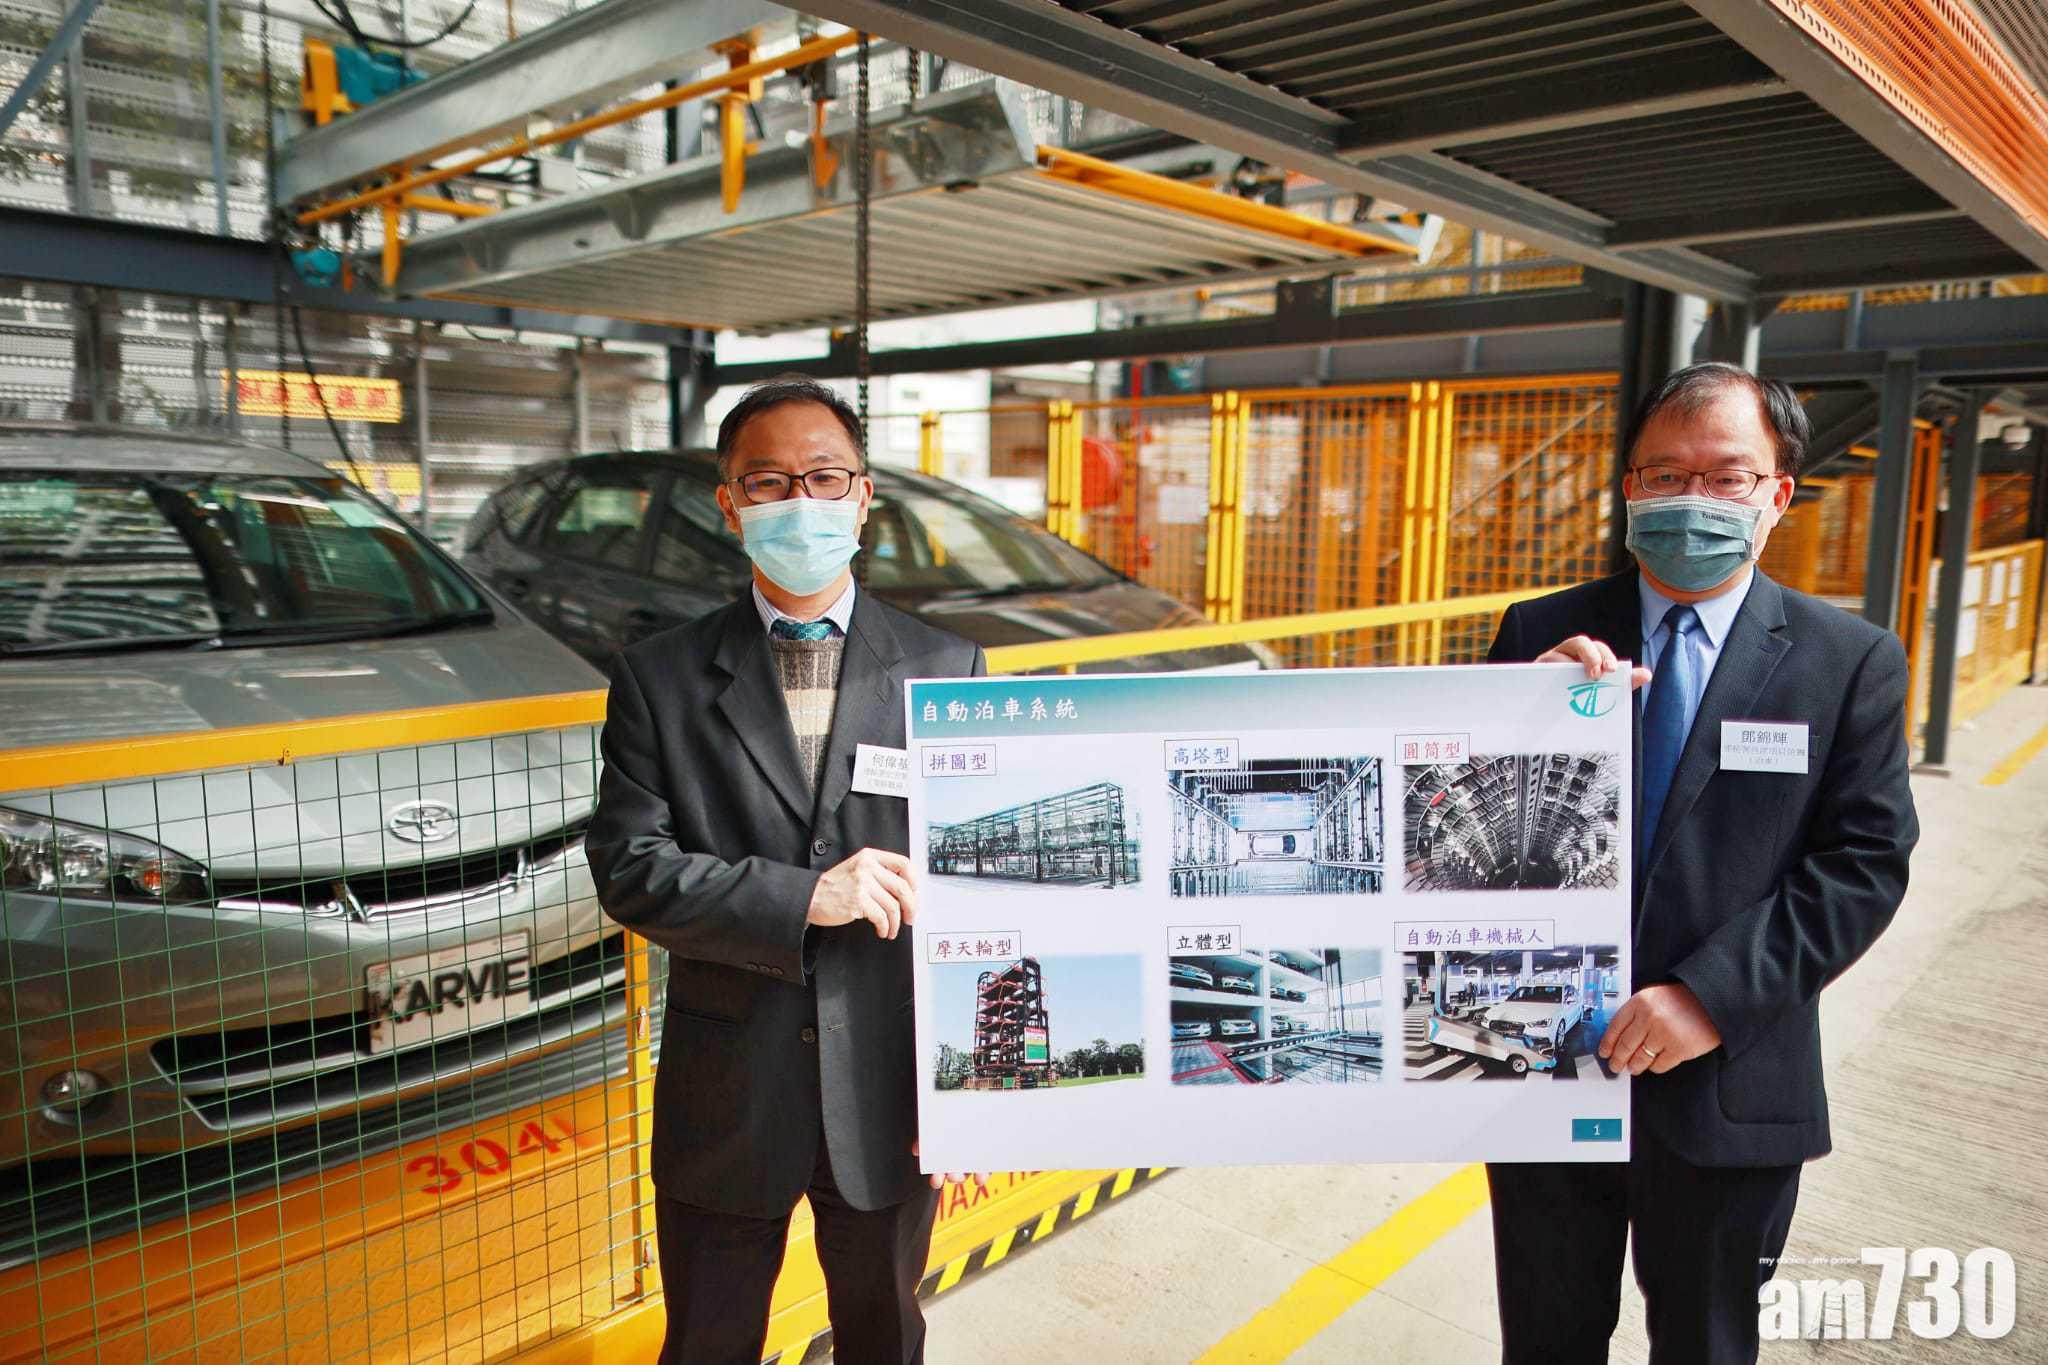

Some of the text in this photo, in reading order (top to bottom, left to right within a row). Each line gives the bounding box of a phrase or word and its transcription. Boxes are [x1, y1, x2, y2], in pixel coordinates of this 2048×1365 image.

[922, 697, 1079, 723] 自動泊車系統
[1174, 746, 1230, 765] 高塔型
[1404, 741, 1460, 760] 圓筒型
[929, 753, 987, 771] 拼圖型
[1176, 932, 1232, 951] 立體型
[1407, 927, 1545, 946] 自動泊車機械人
[936, 938, 1012, 959] 摩天輪型
[1593, 1124, 1601, 1136] 1
